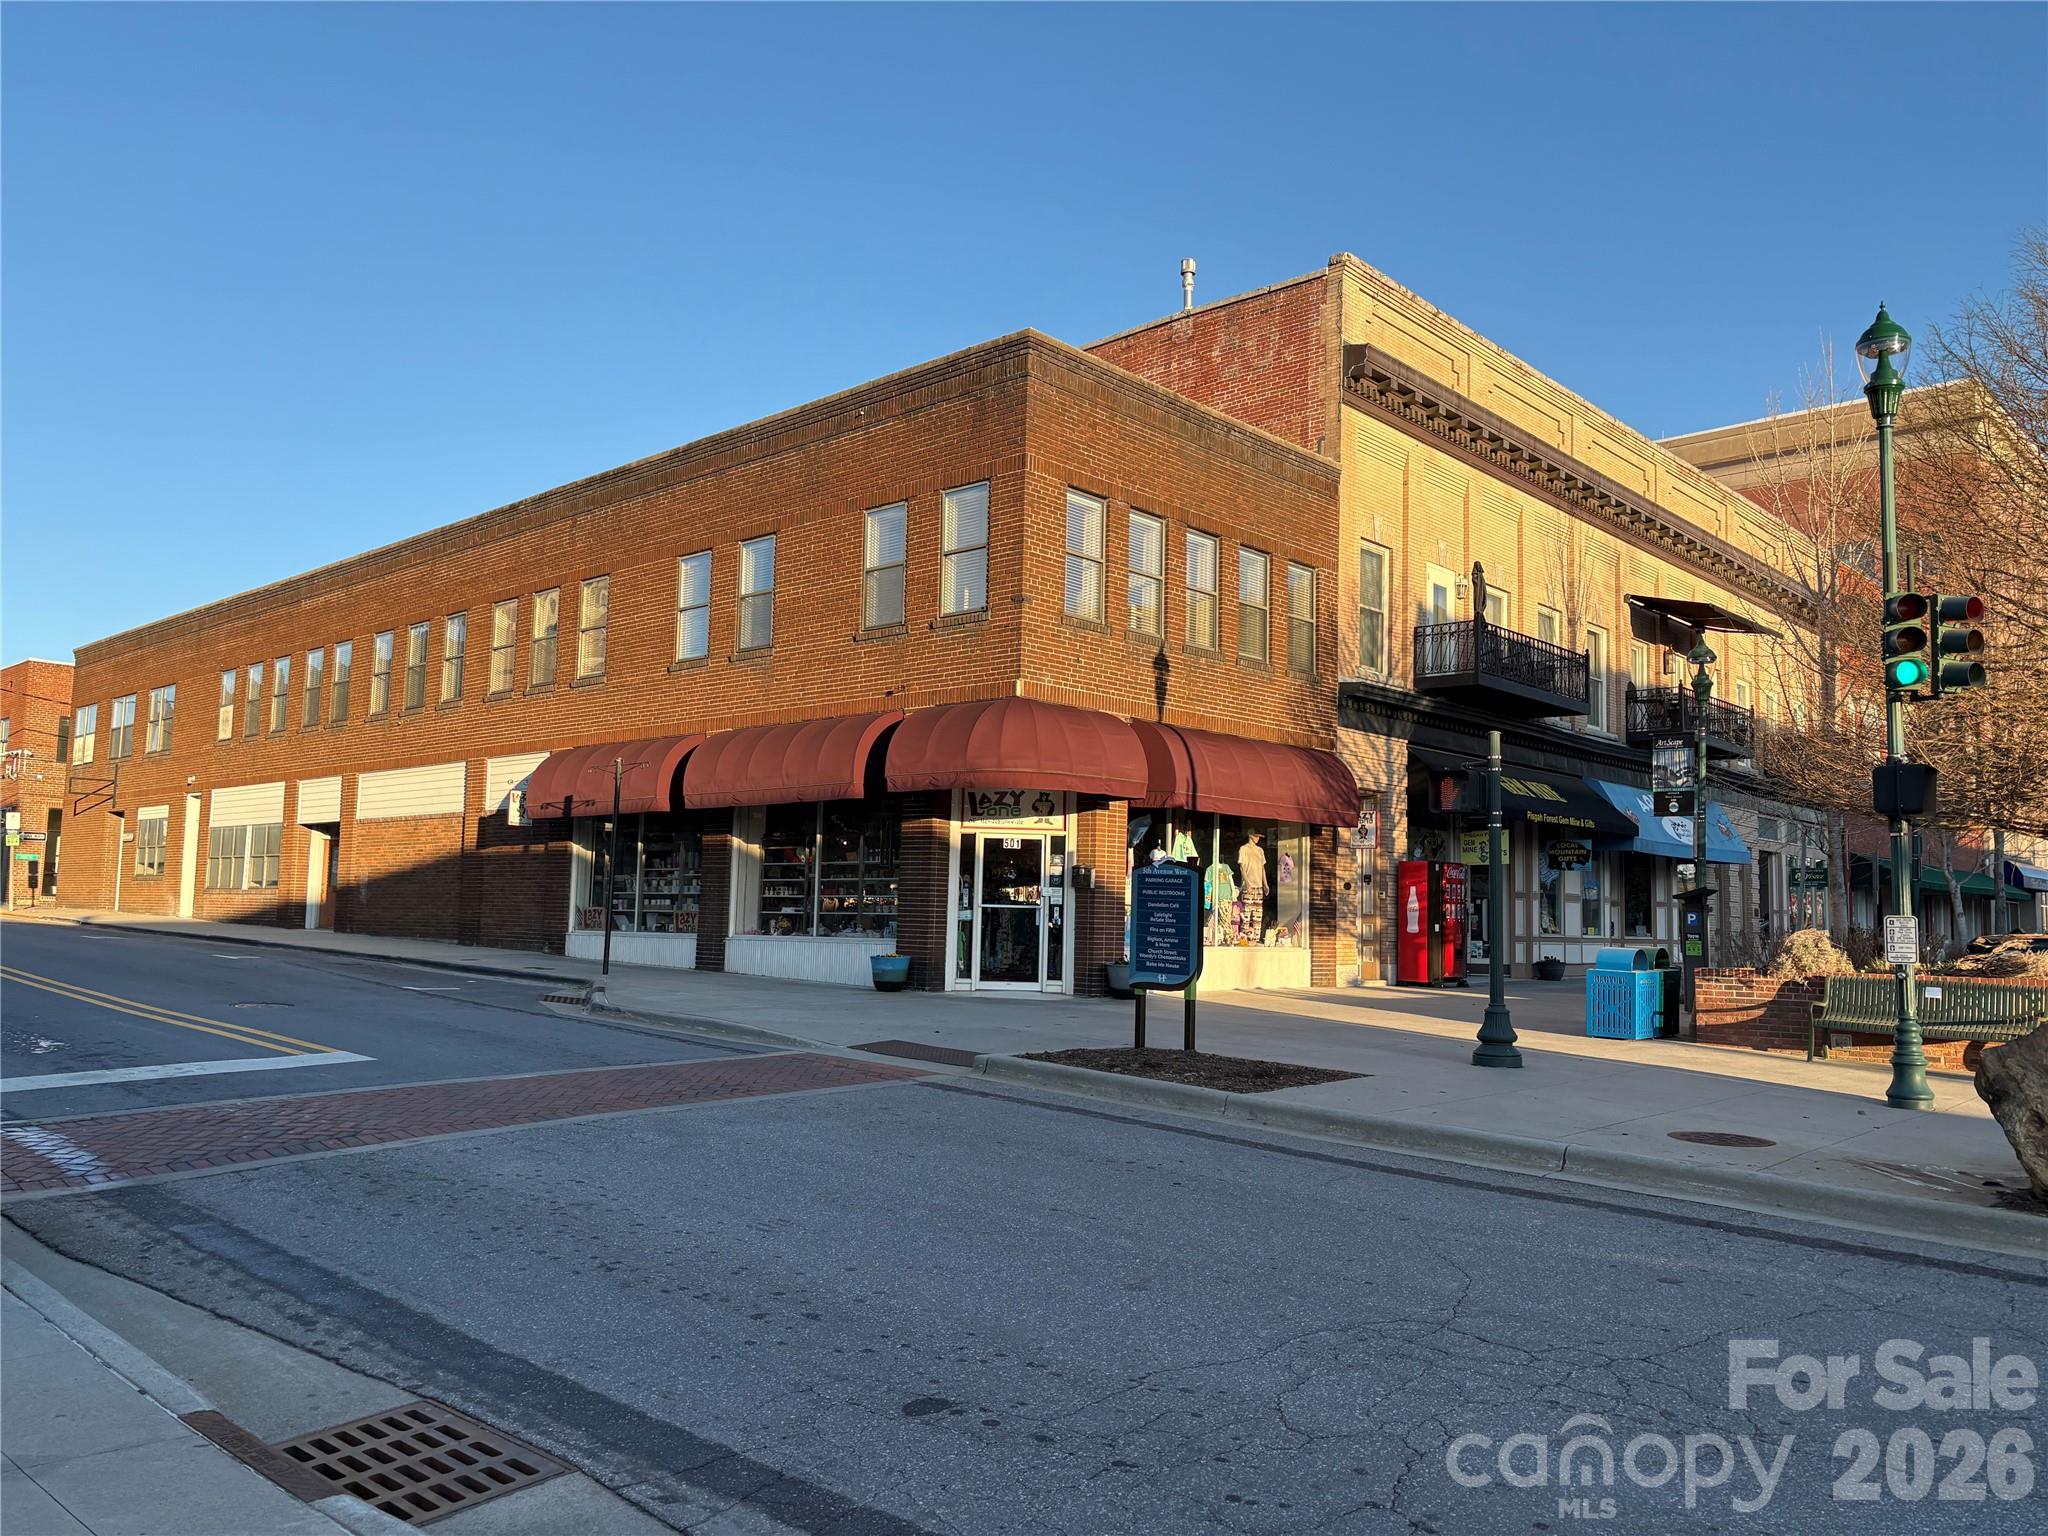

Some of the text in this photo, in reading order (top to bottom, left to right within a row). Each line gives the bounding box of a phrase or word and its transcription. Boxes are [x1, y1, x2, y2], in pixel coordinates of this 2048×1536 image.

[1527, 811, 1543, 822] Pisgah
[1544, 813, 1558, 824] Forest
[1559, 815, 1569, 825] Gem
[1570, 817, 1580, 827] Mine
[1585, 819, 1595, 828] Gifts
[1004, 839, 1020, 848] 501
[1687, 913, 1696, 924] P
